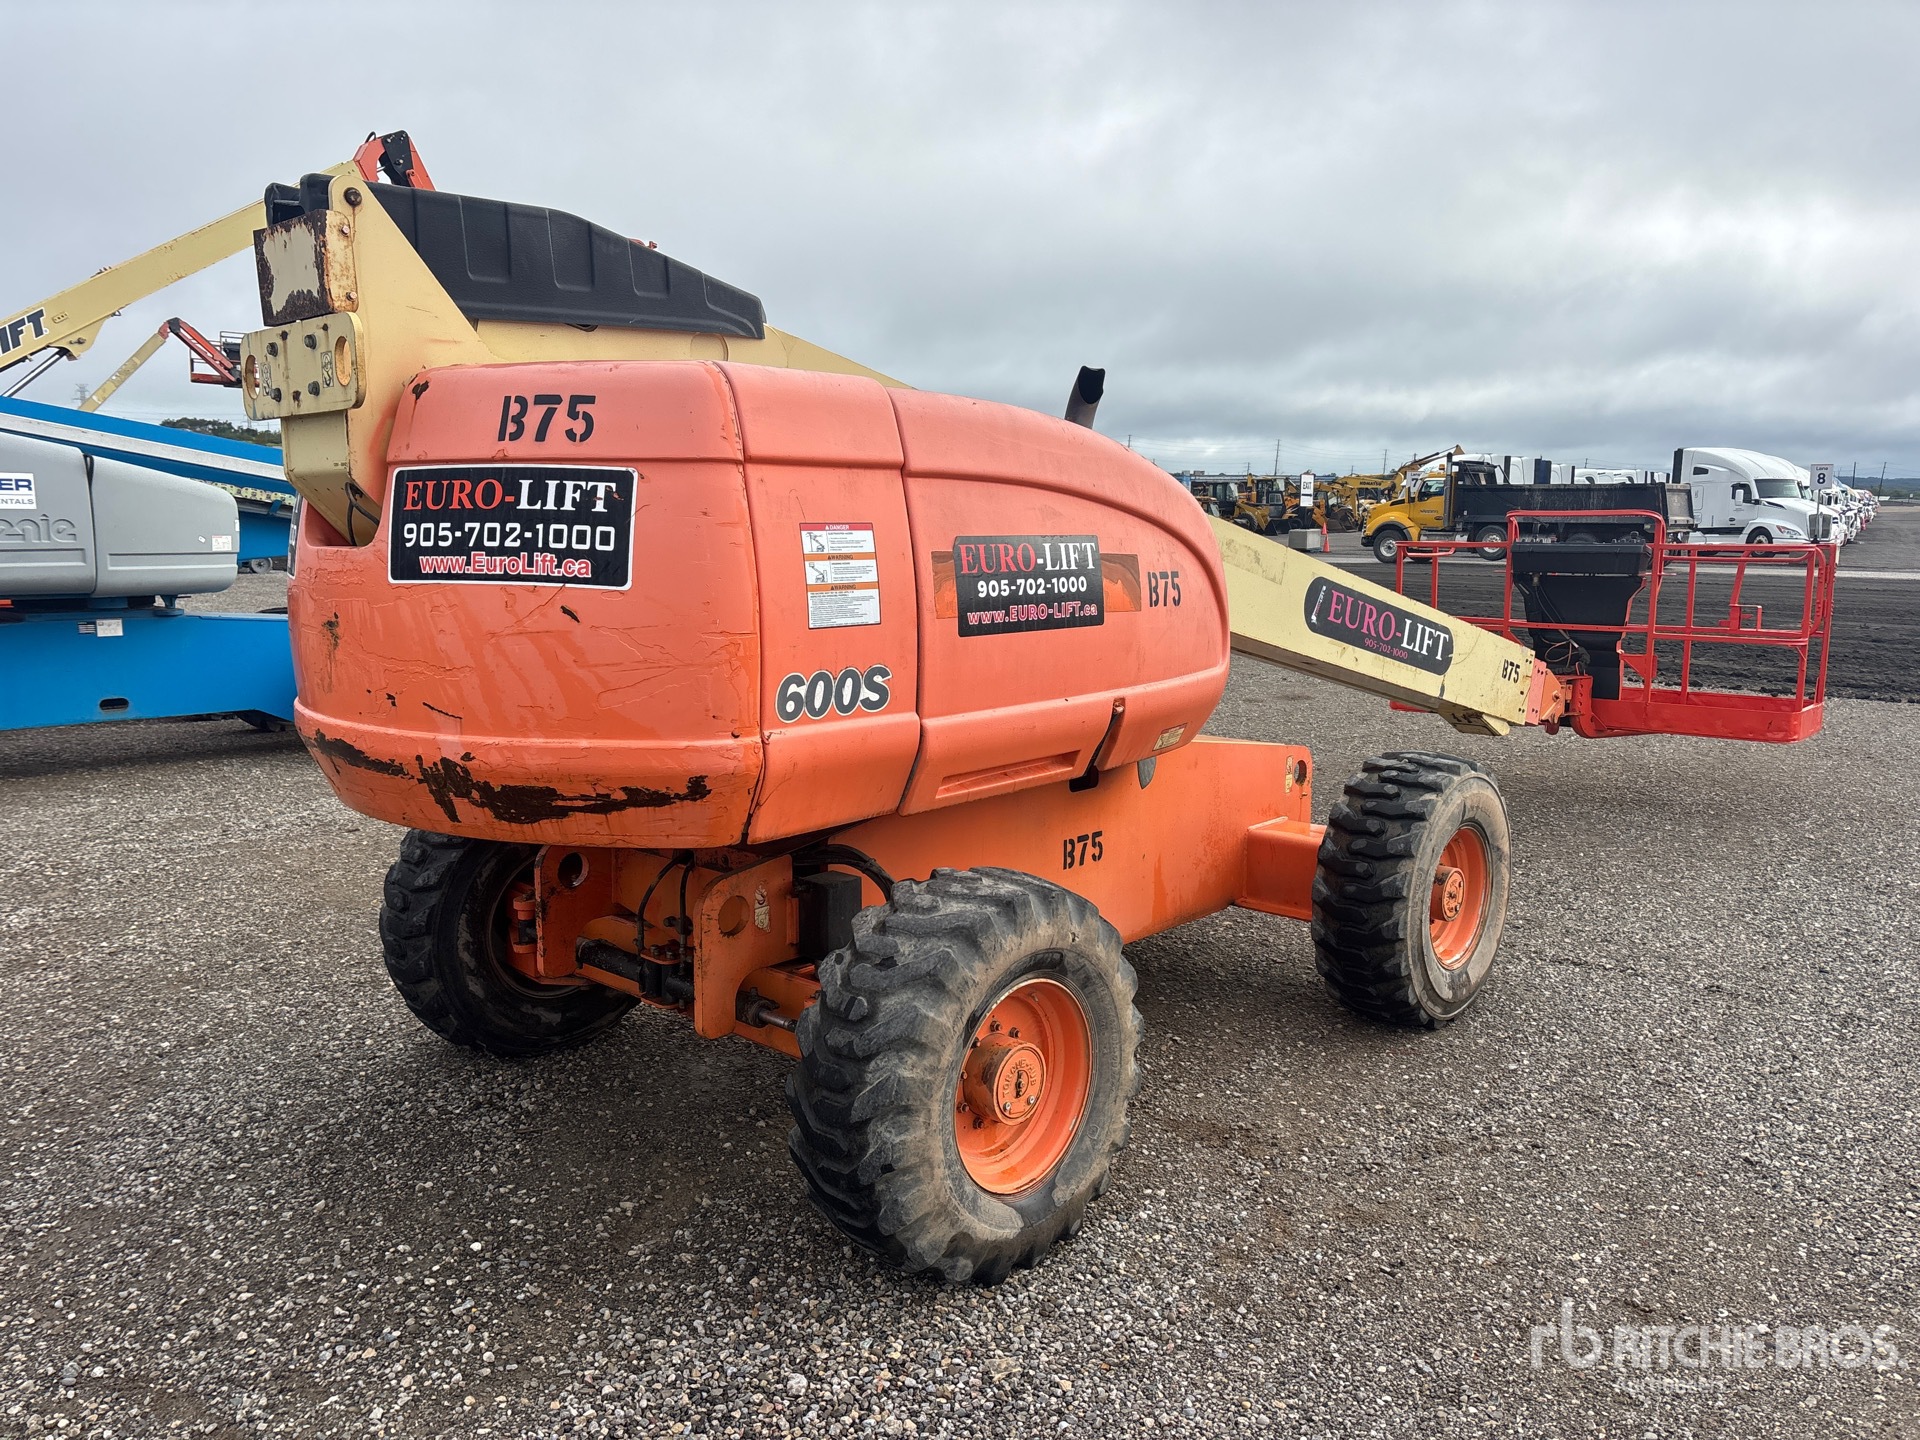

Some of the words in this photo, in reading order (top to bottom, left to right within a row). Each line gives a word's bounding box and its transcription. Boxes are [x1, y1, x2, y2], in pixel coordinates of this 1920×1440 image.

[497, 394, 596, 442] B75
[1303, 482, 1312, 490] EXIT
[1411, 477, 1418, 487] 7
[1817, 473, 1826, 484] 8
[403, 479, 617, 512] EURO-LIFT
[403, 522, 616, 551] 905-702-1000
[419, 551, 592, 578] www.EuroLift.ca
[958, 543, 1096, 574] EURO-LIFT
[977, 576, 1087, 597] 905-702-1000
[1147, 571, 1181, 607] B75
[967, 601, 1098, 625] www.EURO-LIFT.ca
[1327, 590, 1449, 660] EURO-LIFT
[1364, 638, 1408, 660] 905-702-1000
[1502, 659, 1521, 684] B75
[775, 664, 893, 723] 600S
[1063, 831, 1103, 870] B75
